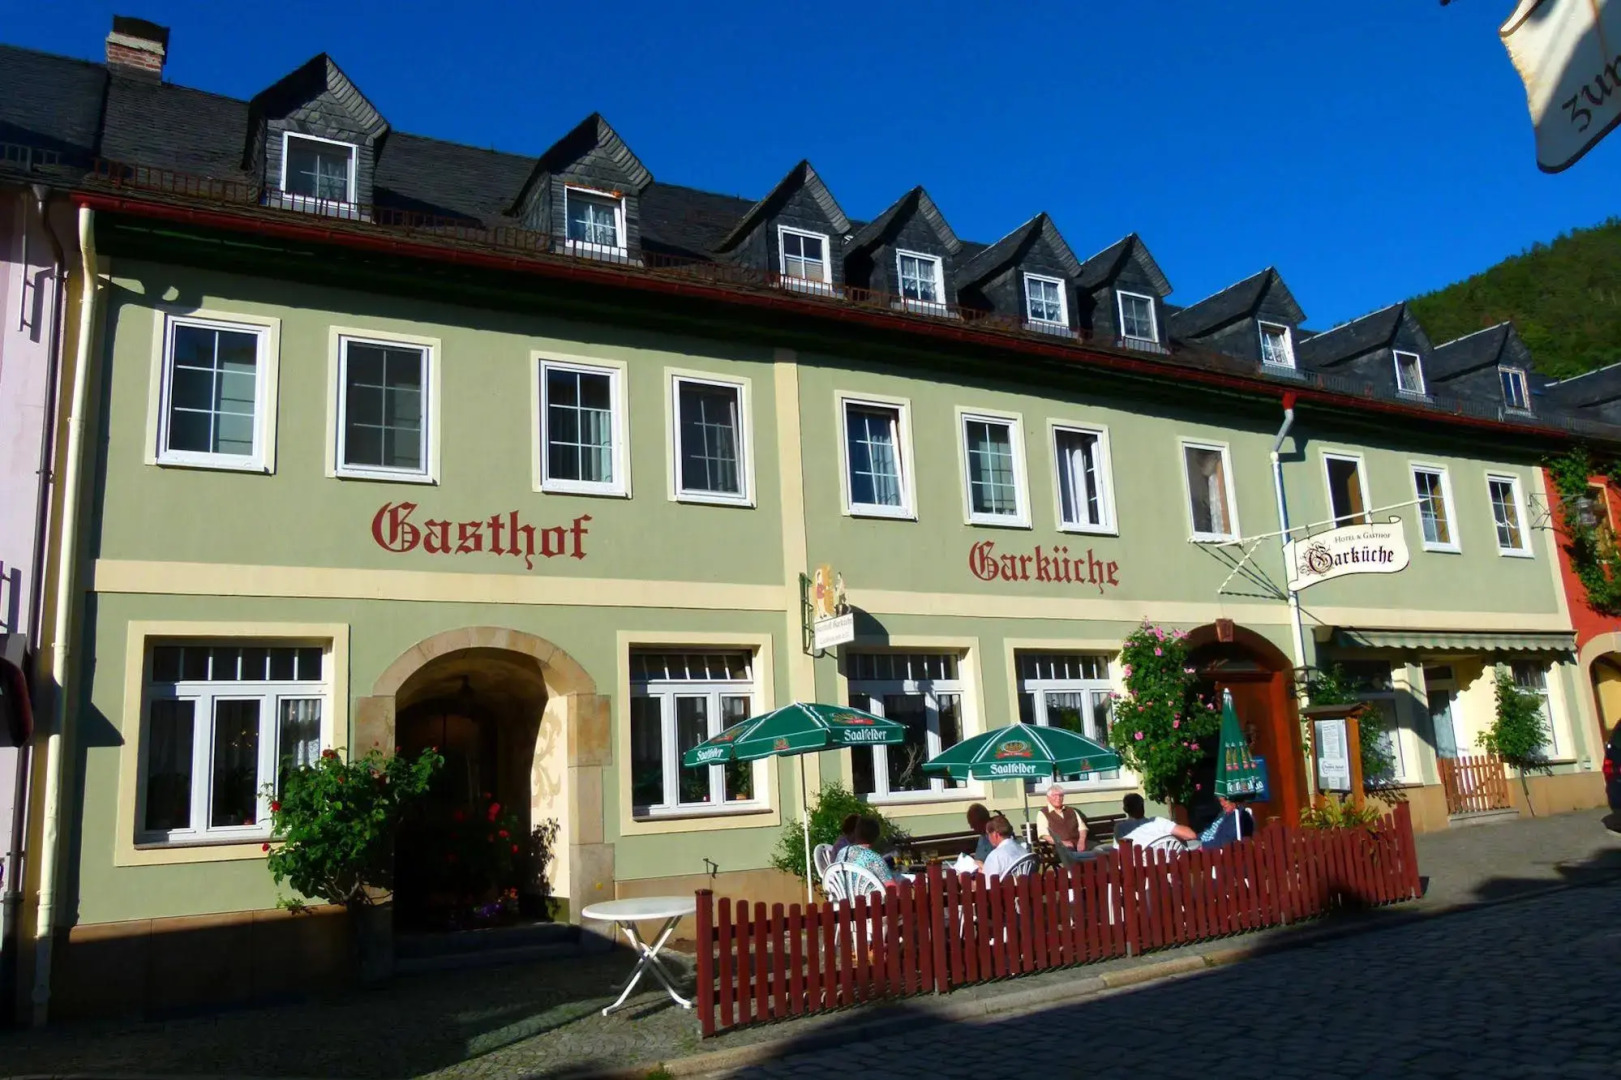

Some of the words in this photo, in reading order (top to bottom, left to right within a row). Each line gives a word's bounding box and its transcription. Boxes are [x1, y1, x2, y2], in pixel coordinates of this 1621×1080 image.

[371, 501, 593, 570] Gasthof
[969, 540, 1120, 594] Garküche
[1304, 543, 1394, 575] Garküche
[844, 728, 887, 741] Saalfelder
[990, 763, 1037, 774] Saalfelder
